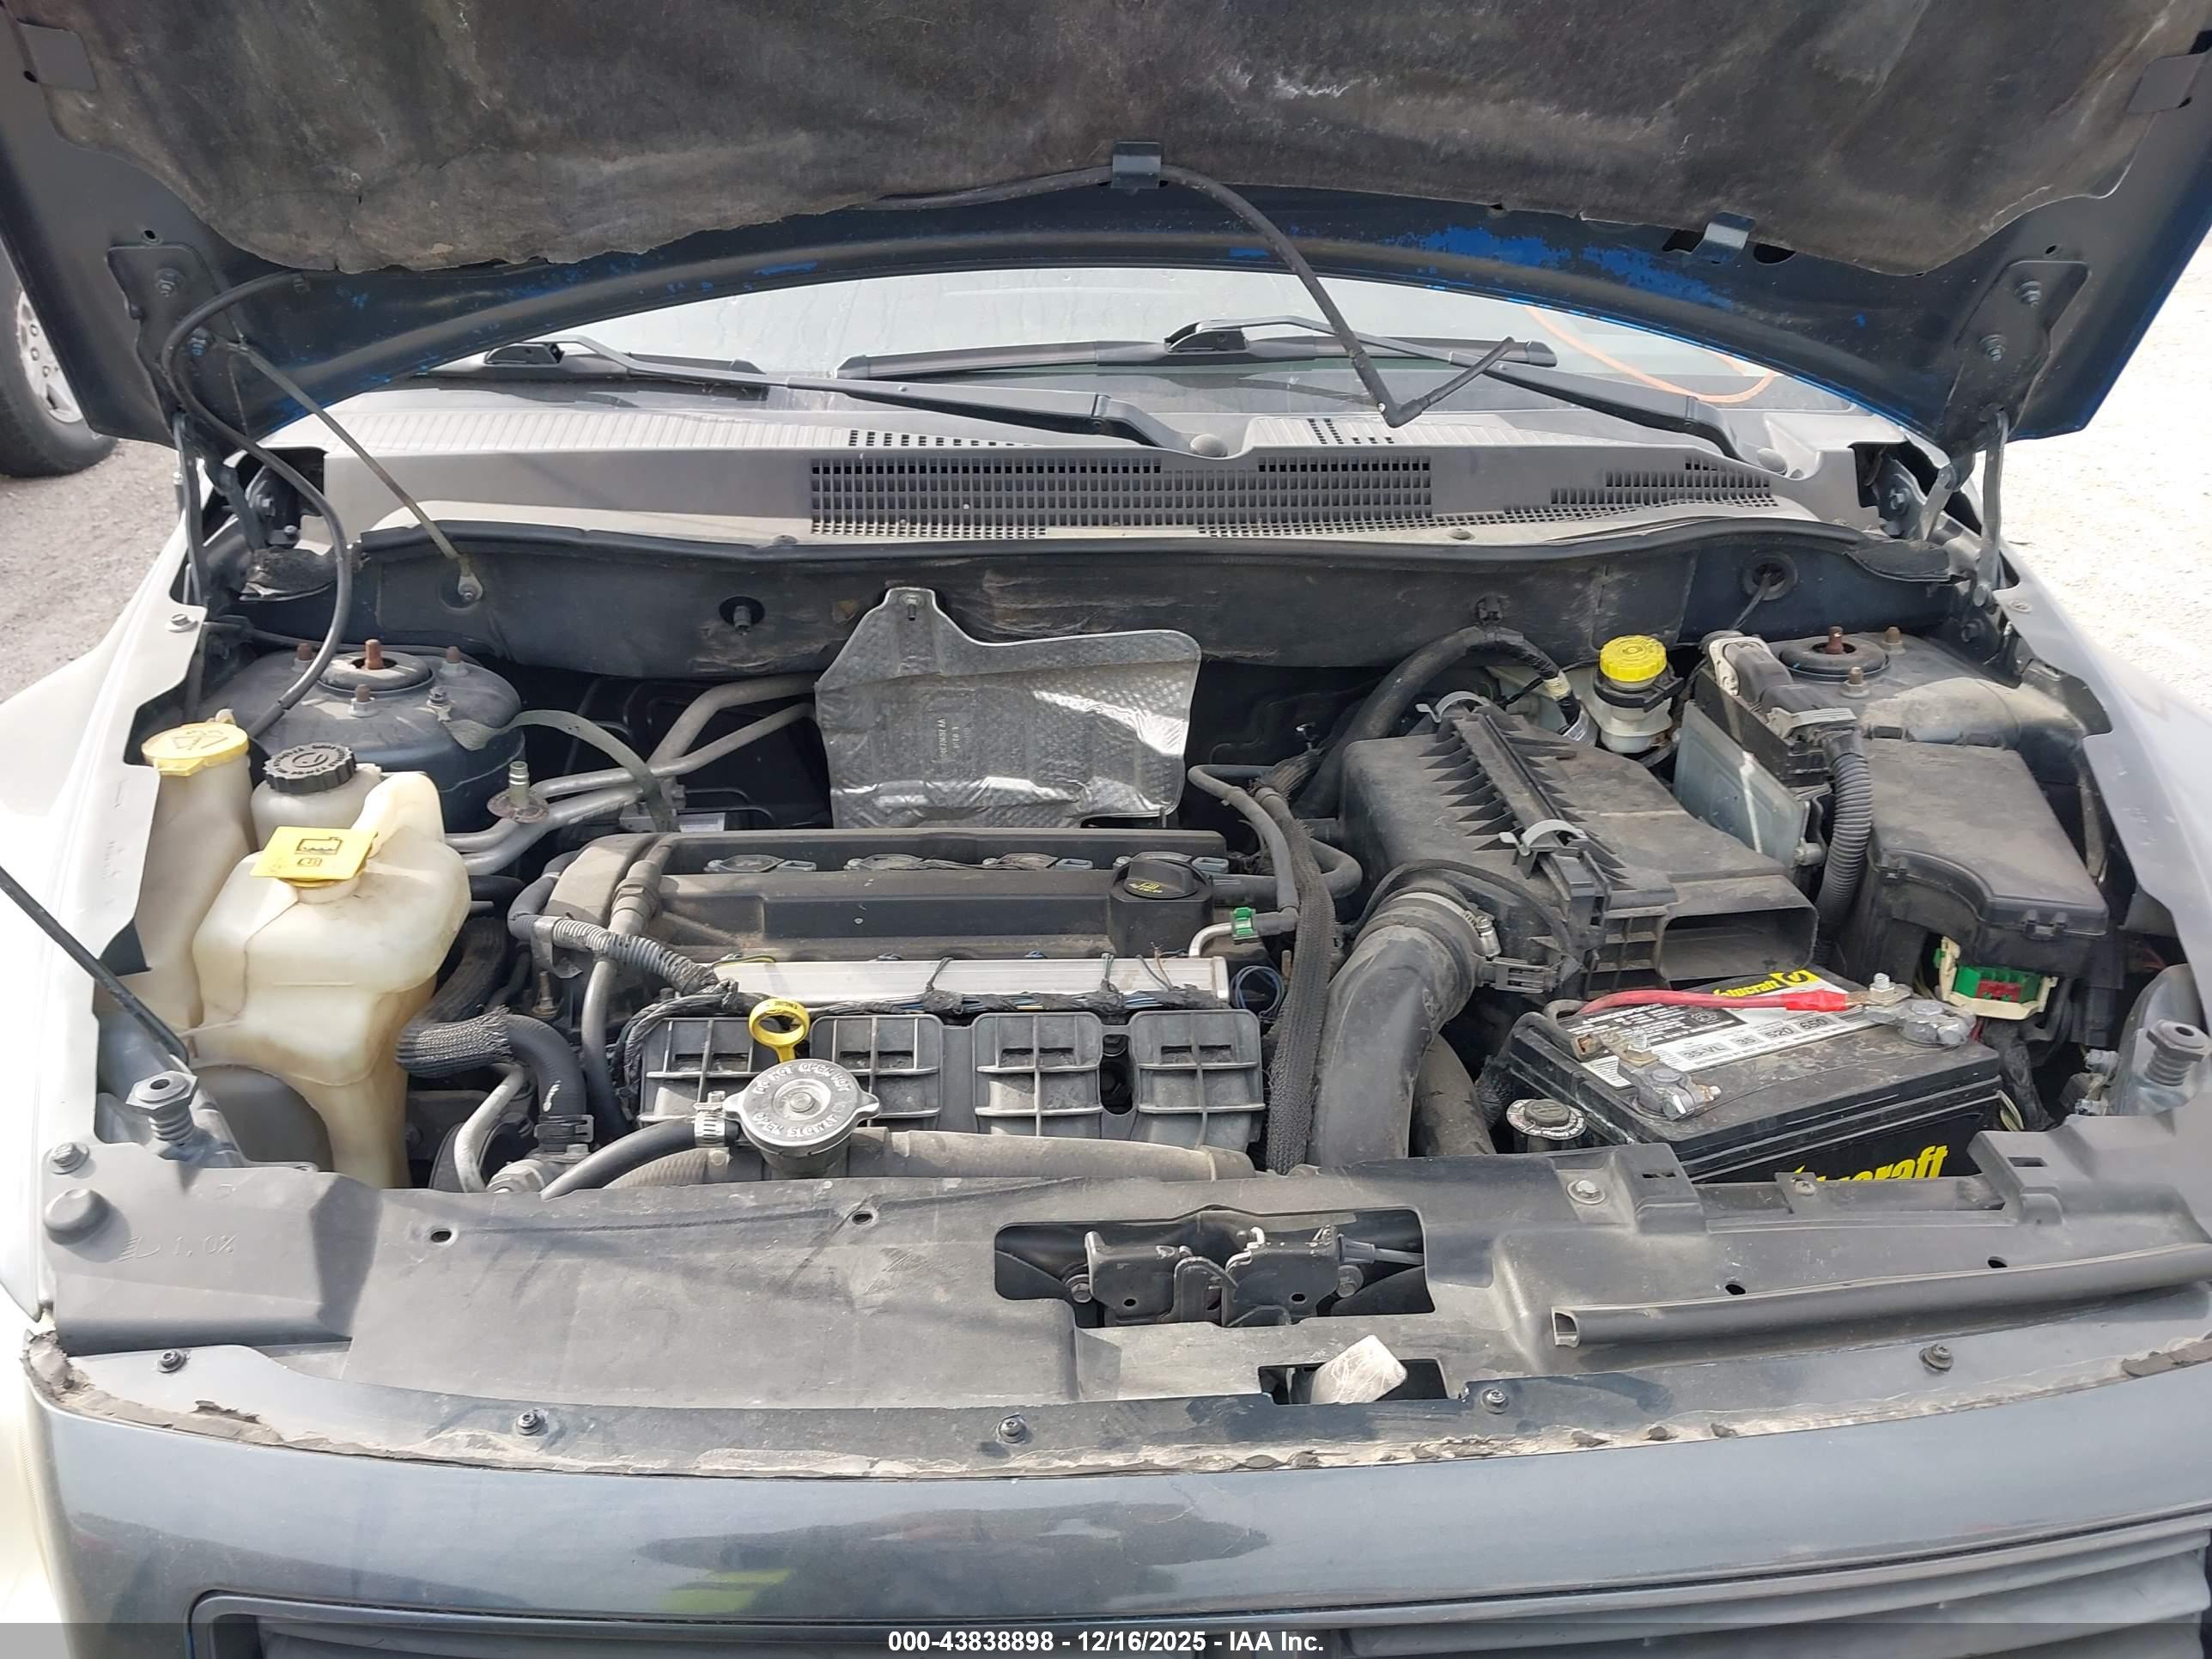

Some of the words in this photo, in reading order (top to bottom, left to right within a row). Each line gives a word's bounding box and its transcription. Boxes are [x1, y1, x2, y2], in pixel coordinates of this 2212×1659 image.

[1712, 980, 1781, 997] lucraft
[1800, 1018, 1828, 1030] 650
[1765, 1027, 1794, 1038] 520
[1735, 1036, 1757, 1045] 35
[1683, 1045, 1725, 1059] 35-VL
[752, 1080, 770, 1095] DO
[767, 1065, 793, 1081] NOT
[798, 1062, 834, 1078] OPEN
[830, 1072, 853, 1092] HOT
[752, 1112, 784, 1135] OPEN
[787, 1114, 839, 1138] SLOWLY
